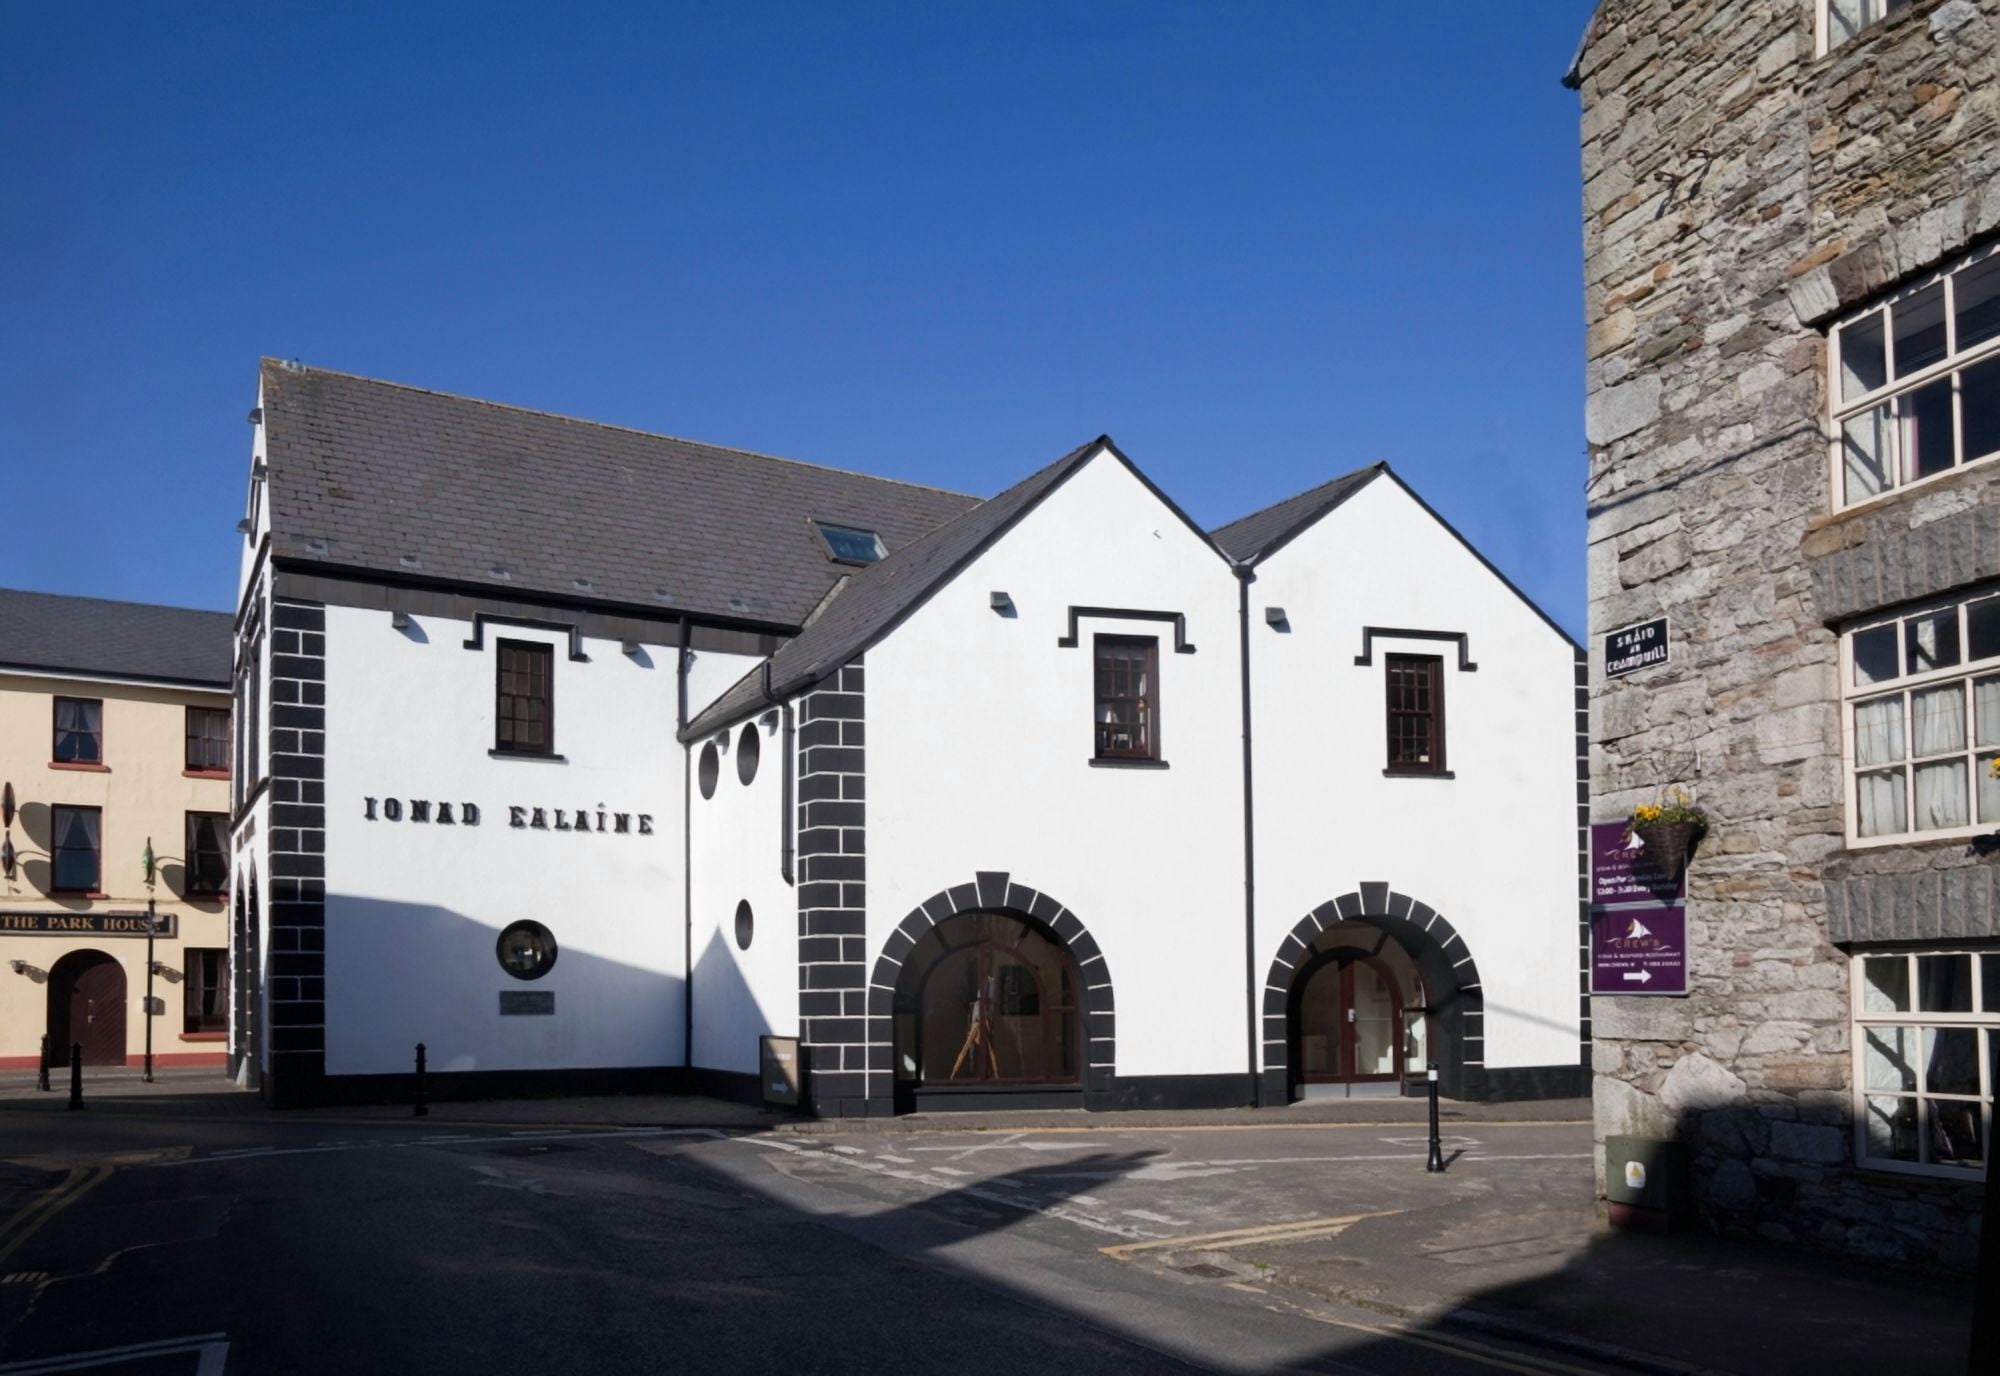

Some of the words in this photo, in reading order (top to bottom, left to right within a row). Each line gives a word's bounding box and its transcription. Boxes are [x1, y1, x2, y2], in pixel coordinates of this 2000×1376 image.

[364, 797, 479, 826] IONAD
[508, 803, 654, 835] EALAÍNE
[2, 915, 39, 929] THE
[47, 917, 94, 930] PARK
